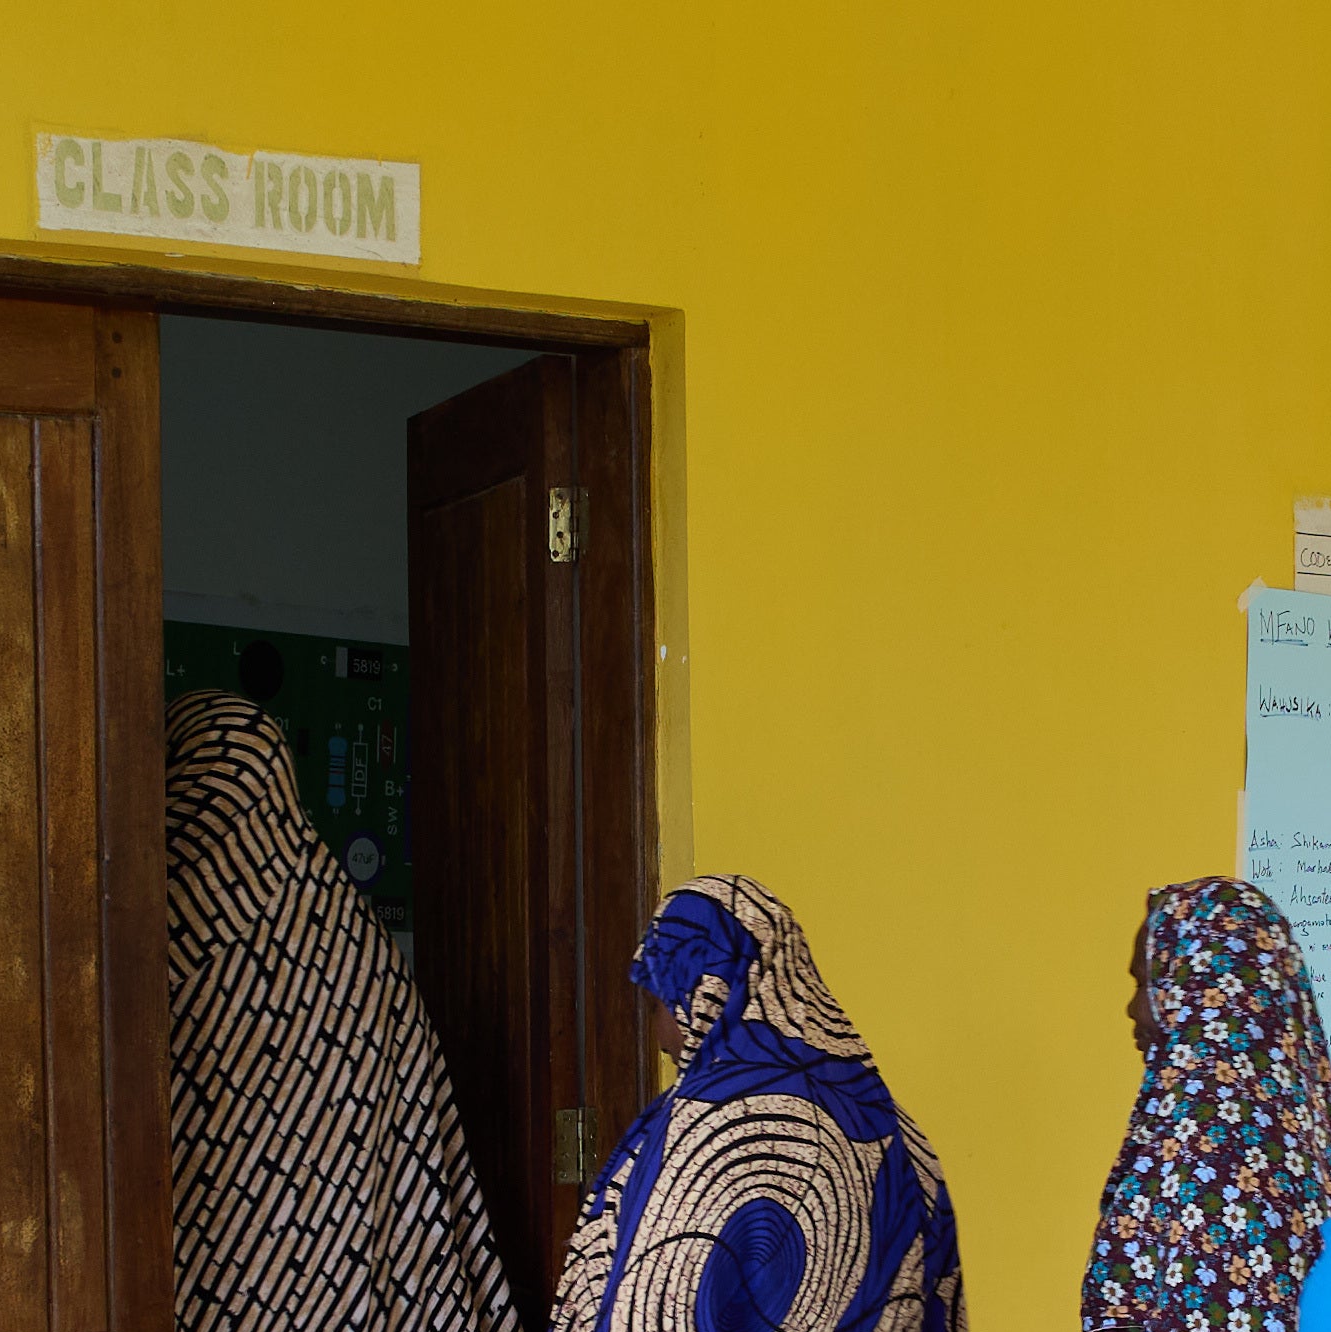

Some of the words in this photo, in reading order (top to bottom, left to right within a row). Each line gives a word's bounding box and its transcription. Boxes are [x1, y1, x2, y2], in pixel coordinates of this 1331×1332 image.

[53, 138, 229, 223] CLASS
[253, 160, 397, 242] ROOM
[1260, 608, 1316, 645] MFANO
[352, 657, 381, 674] 5819
[367, 697, 382, 711] C1
[384, 780, 404, 796] B+
[387, 806, 398, 835] SW
[377, 906, 405, 920] 5819
